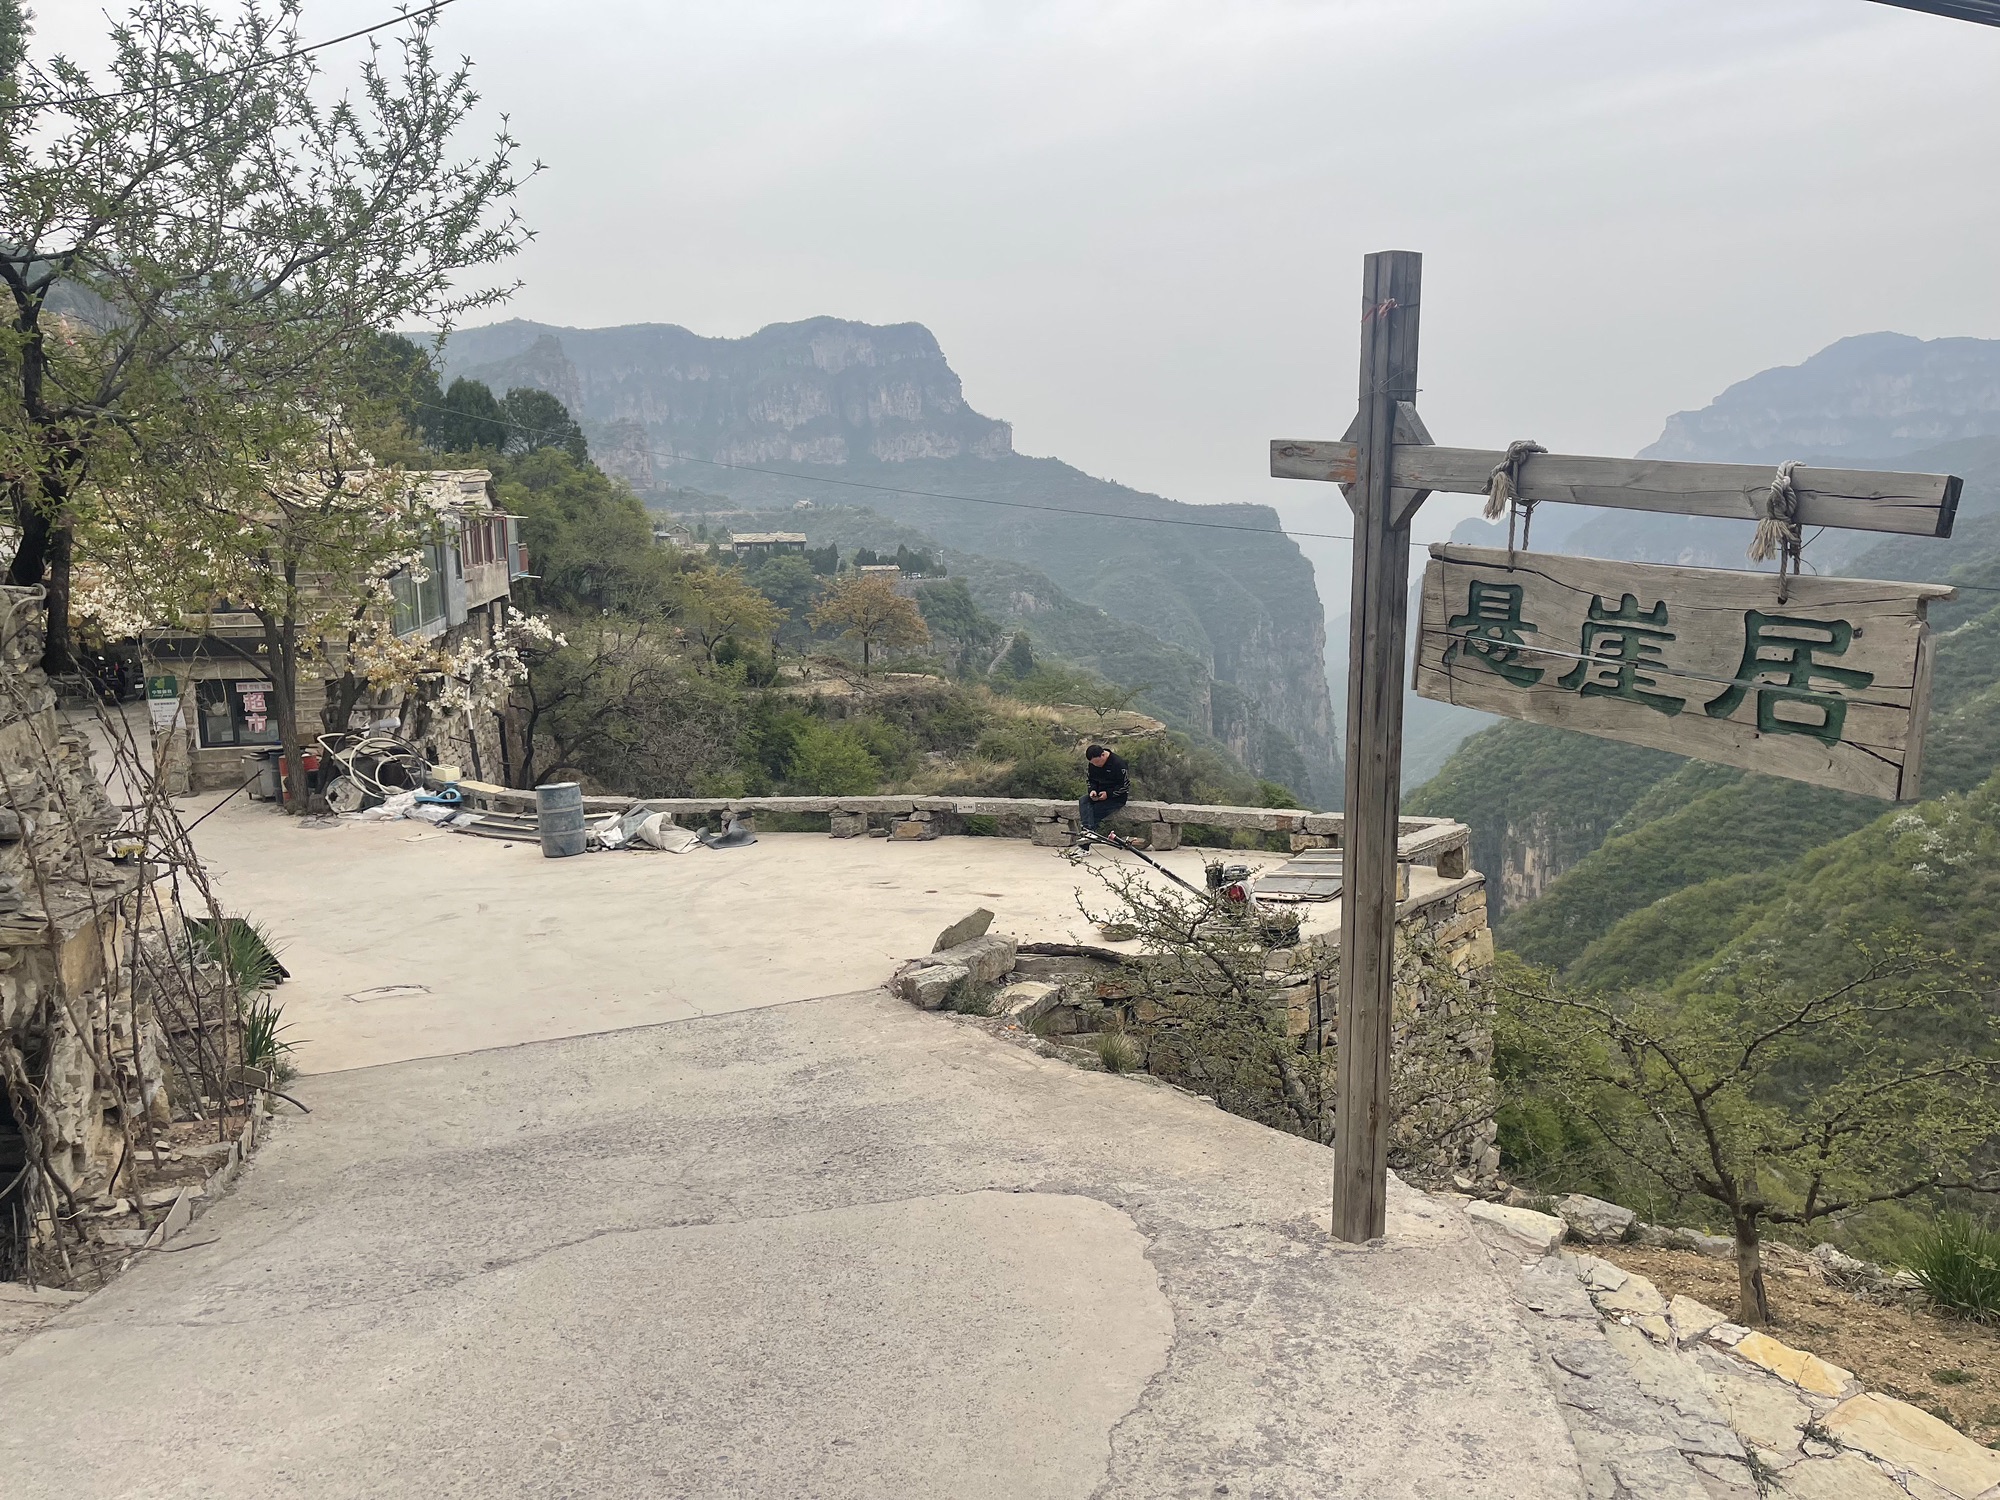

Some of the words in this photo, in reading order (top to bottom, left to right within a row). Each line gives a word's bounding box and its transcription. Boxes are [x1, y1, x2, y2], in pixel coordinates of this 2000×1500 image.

[243, 692, 267, 733] 超市
[1441, 579, 1875, 748] 悬崖居
